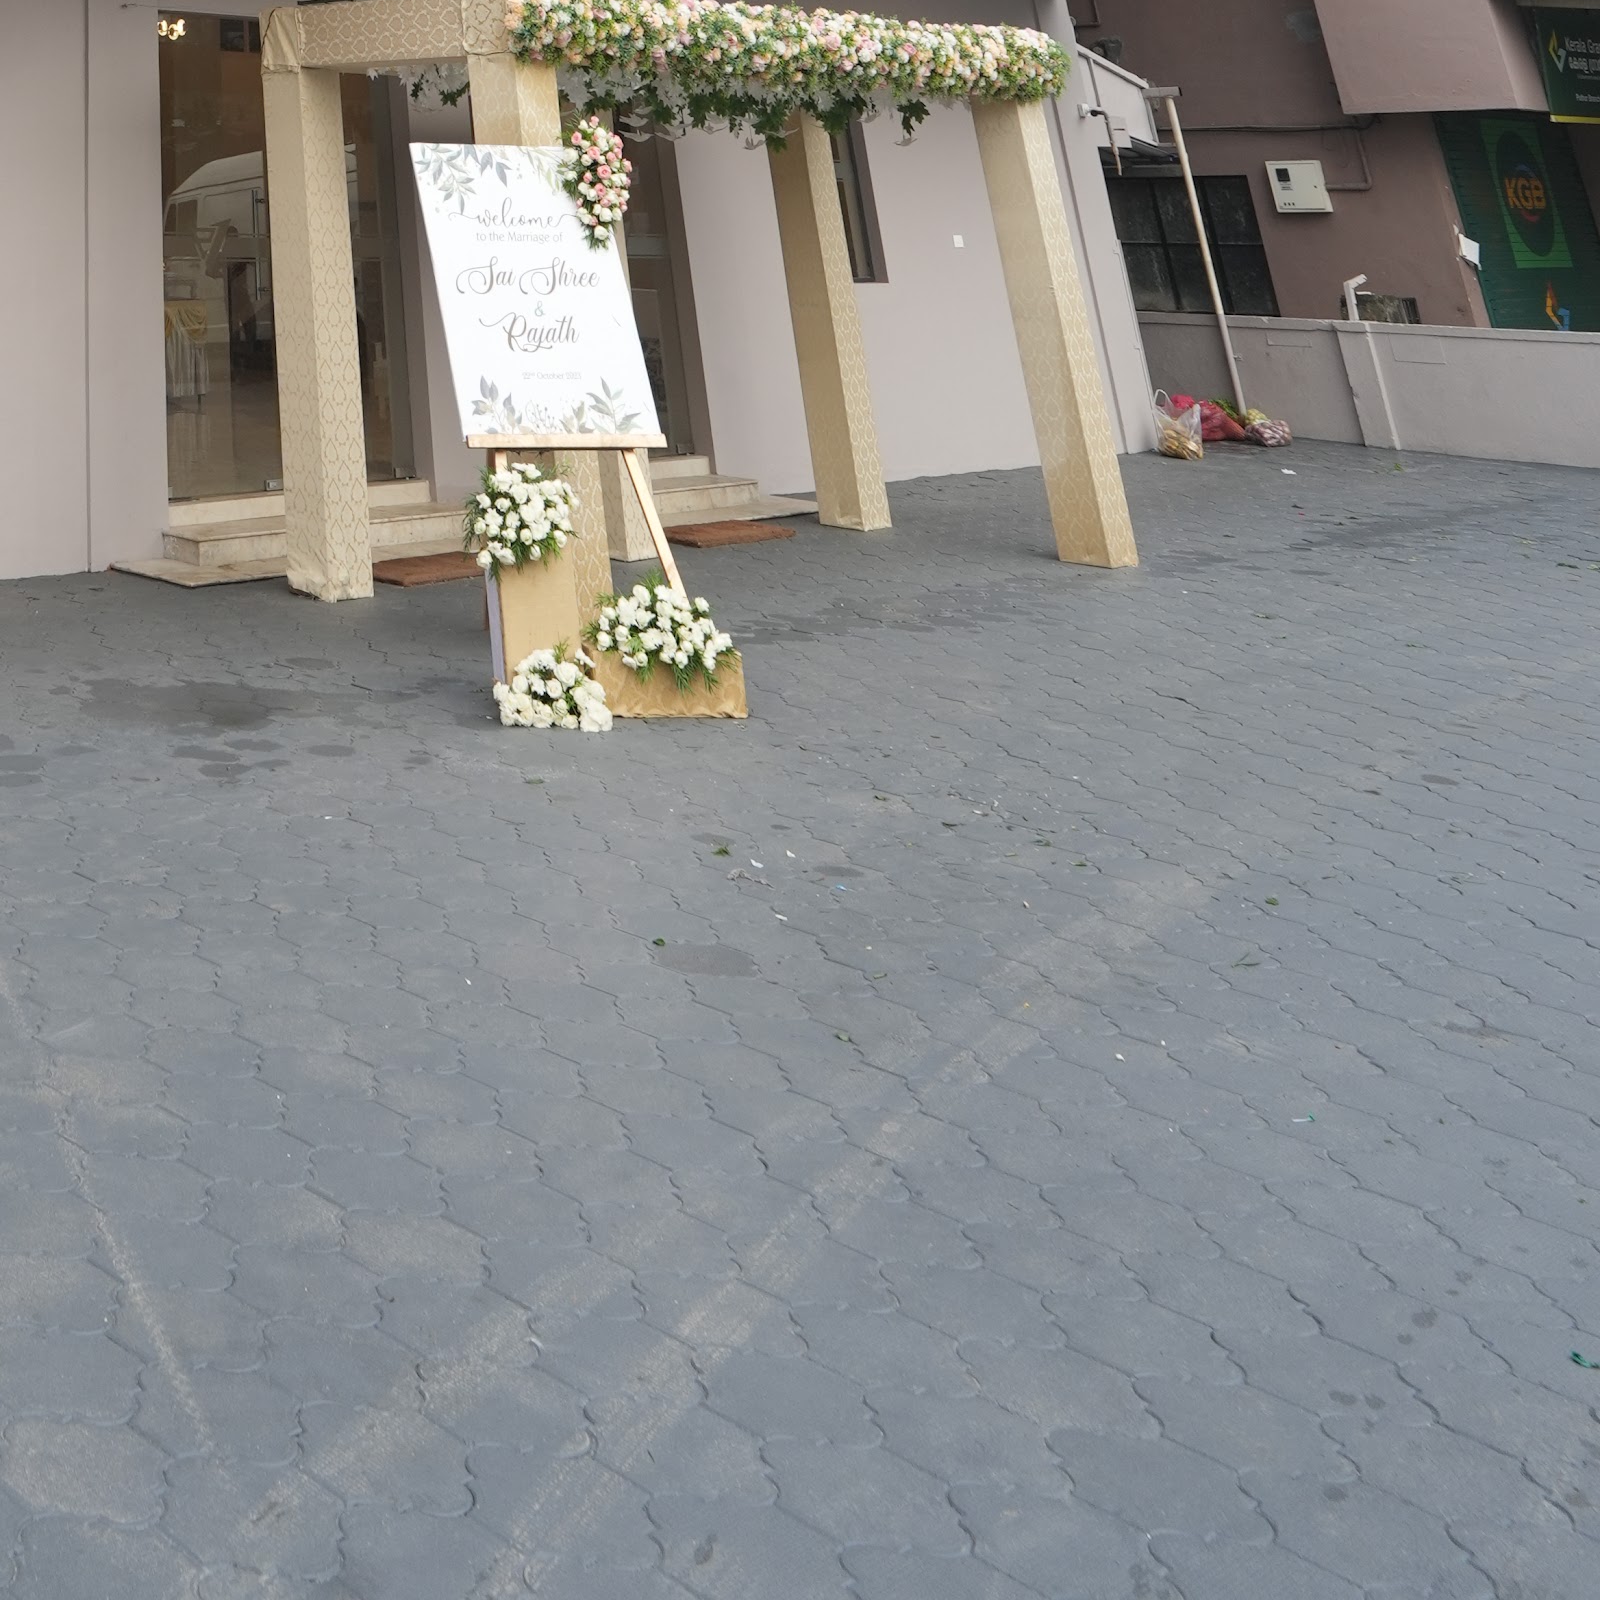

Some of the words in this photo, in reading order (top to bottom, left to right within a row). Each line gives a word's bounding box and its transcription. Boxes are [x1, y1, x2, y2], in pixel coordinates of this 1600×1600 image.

[1564, 36, 1587, 53] Kerala
[1504, 177, 1546, 210] KGB
[448, 197, 577, 228] welcome
[476, 232, 487, 242] to
[489, 231, 505, 242] the
[507, 231, 550, 244] Marriage
[552, 232, 563, 242] of
[456, 256, 516, 295] Sai
[519, 257, 600, 295] Shree
[534, 301, 545, 317] &
[479, 312, 580, 353] Rajath
